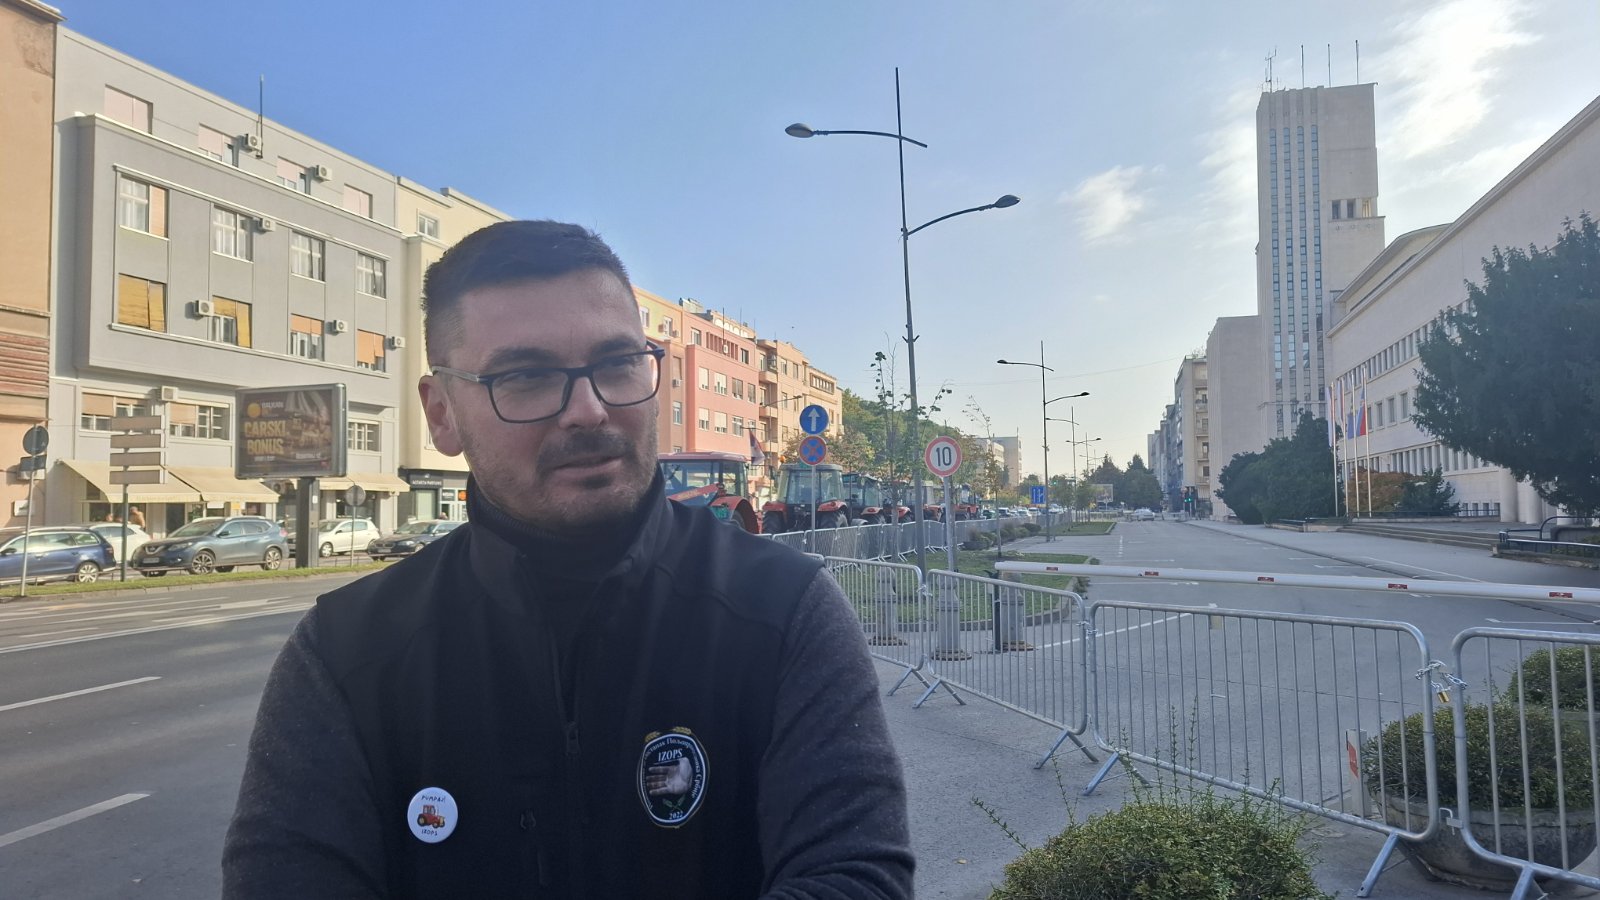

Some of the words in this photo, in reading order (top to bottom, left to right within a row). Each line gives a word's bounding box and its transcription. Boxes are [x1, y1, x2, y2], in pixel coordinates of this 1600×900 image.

[244, 420, 286, 437] CARSKI
[247, 438, 284, 455] BONUS
[936, 446, 952, 467] 10
[658, 749, 683, 761] IZOPS
